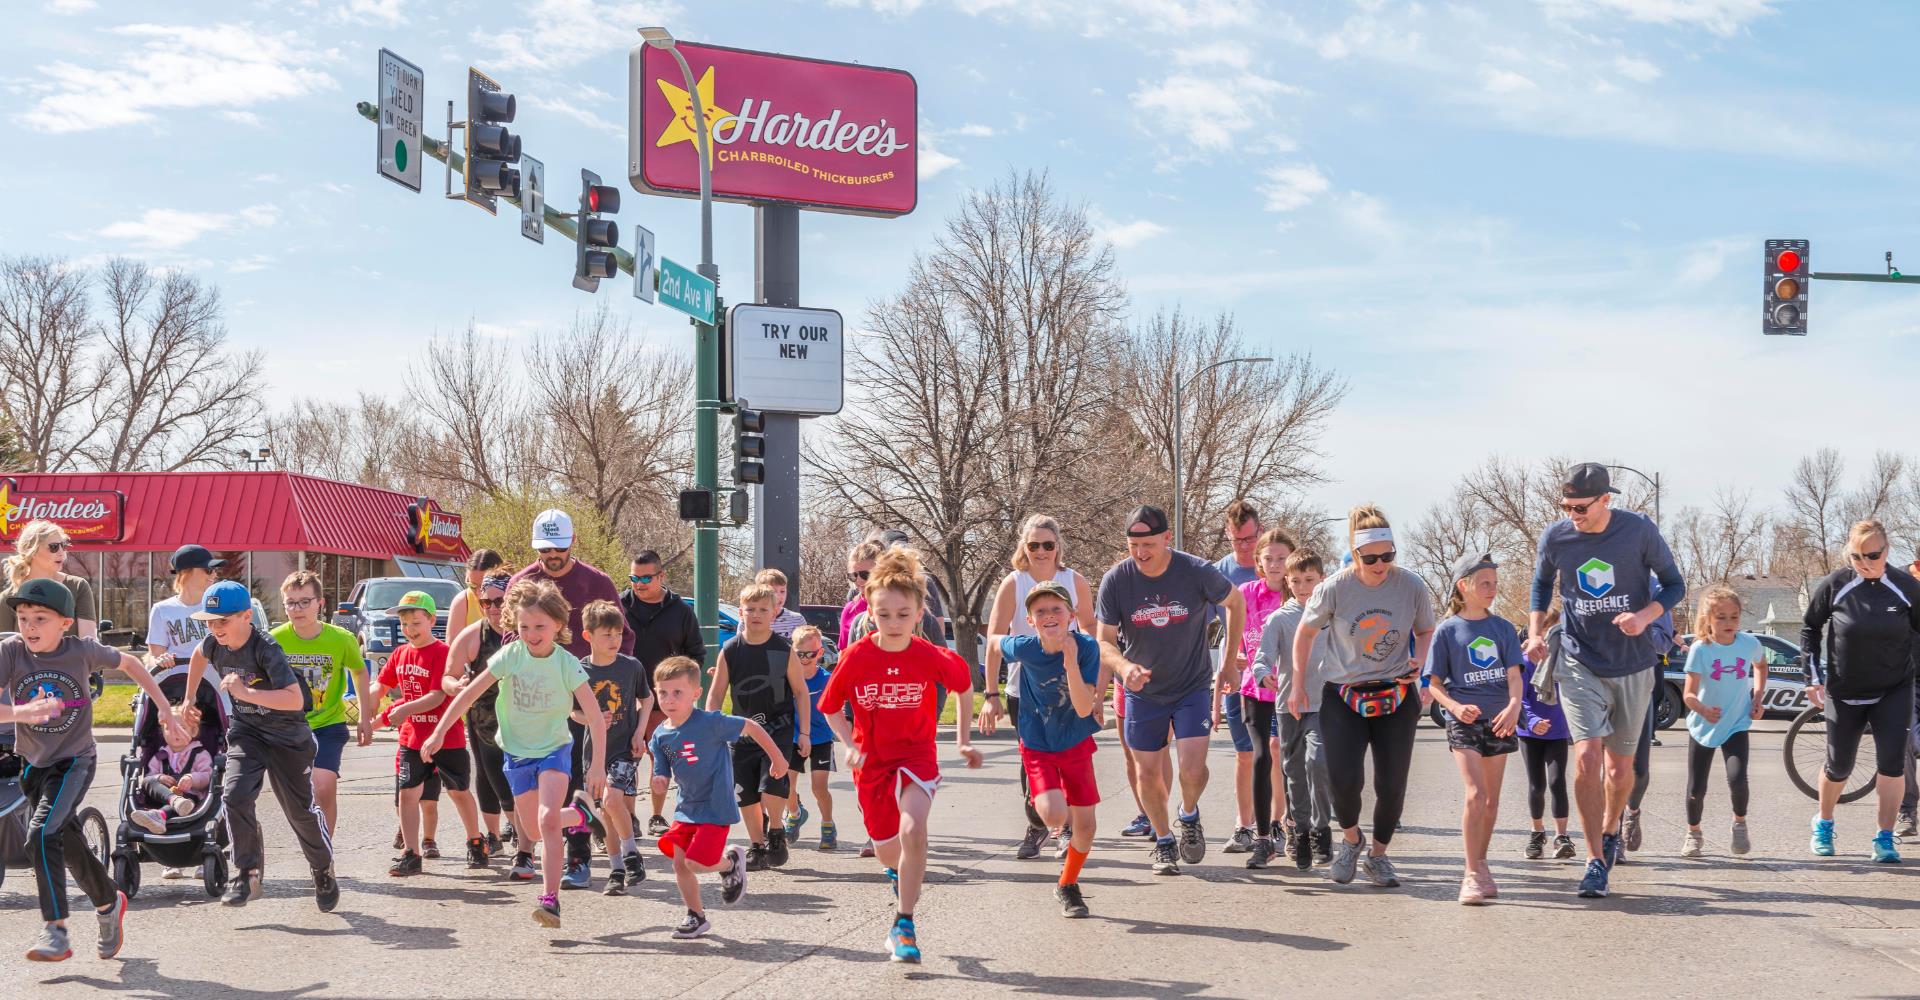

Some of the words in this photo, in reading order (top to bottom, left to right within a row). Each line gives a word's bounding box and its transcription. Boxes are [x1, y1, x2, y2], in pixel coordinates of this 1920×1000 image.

[385, 60, 400, 81] LEFT
[402, 69, 418, 91] TURN
[390, 84, 413, 114] YIELD
[385, 109, 394, 126] ON
[396, 115, 417, 138] GREEN
[712, 98, 909, 157] Hardee's
[718, 150, 810, 174] CHARBROILED
[812, 168, 895, 185] THICKBURGERS
[662, 268, 681, 300] 2nd
[683, 279, 701, 309] Ave
[704, 287, 712, 313] W
[761, 323, 790, 339] TRY
[799, 325, 828, 341] OUR
[780, 343, 808, 359] NEW
[6, 497, 112, 521] Hardee's
[63, 524, 104, 534] ICKBURGERS
[1463, 667, 1506, 683] CREEDENC
[16, 683, 24, 698] JUMP
[24, 676, 34, 685] ON
[35, 672, 59, 680] BOARD
[60, 675, 76, 688] WITH
[73, 687, 81, 699] THE
[855, 683, 879, 699] US
[881, 681, 928, 697] OPEN
[513, 690, 554, 709] SOME
[1750, 688, 1809, 708] ICE
[30, 724, 48, 733] EART
[411, 714, 427, 723] FOR
[427, 714, 438, 723] US
